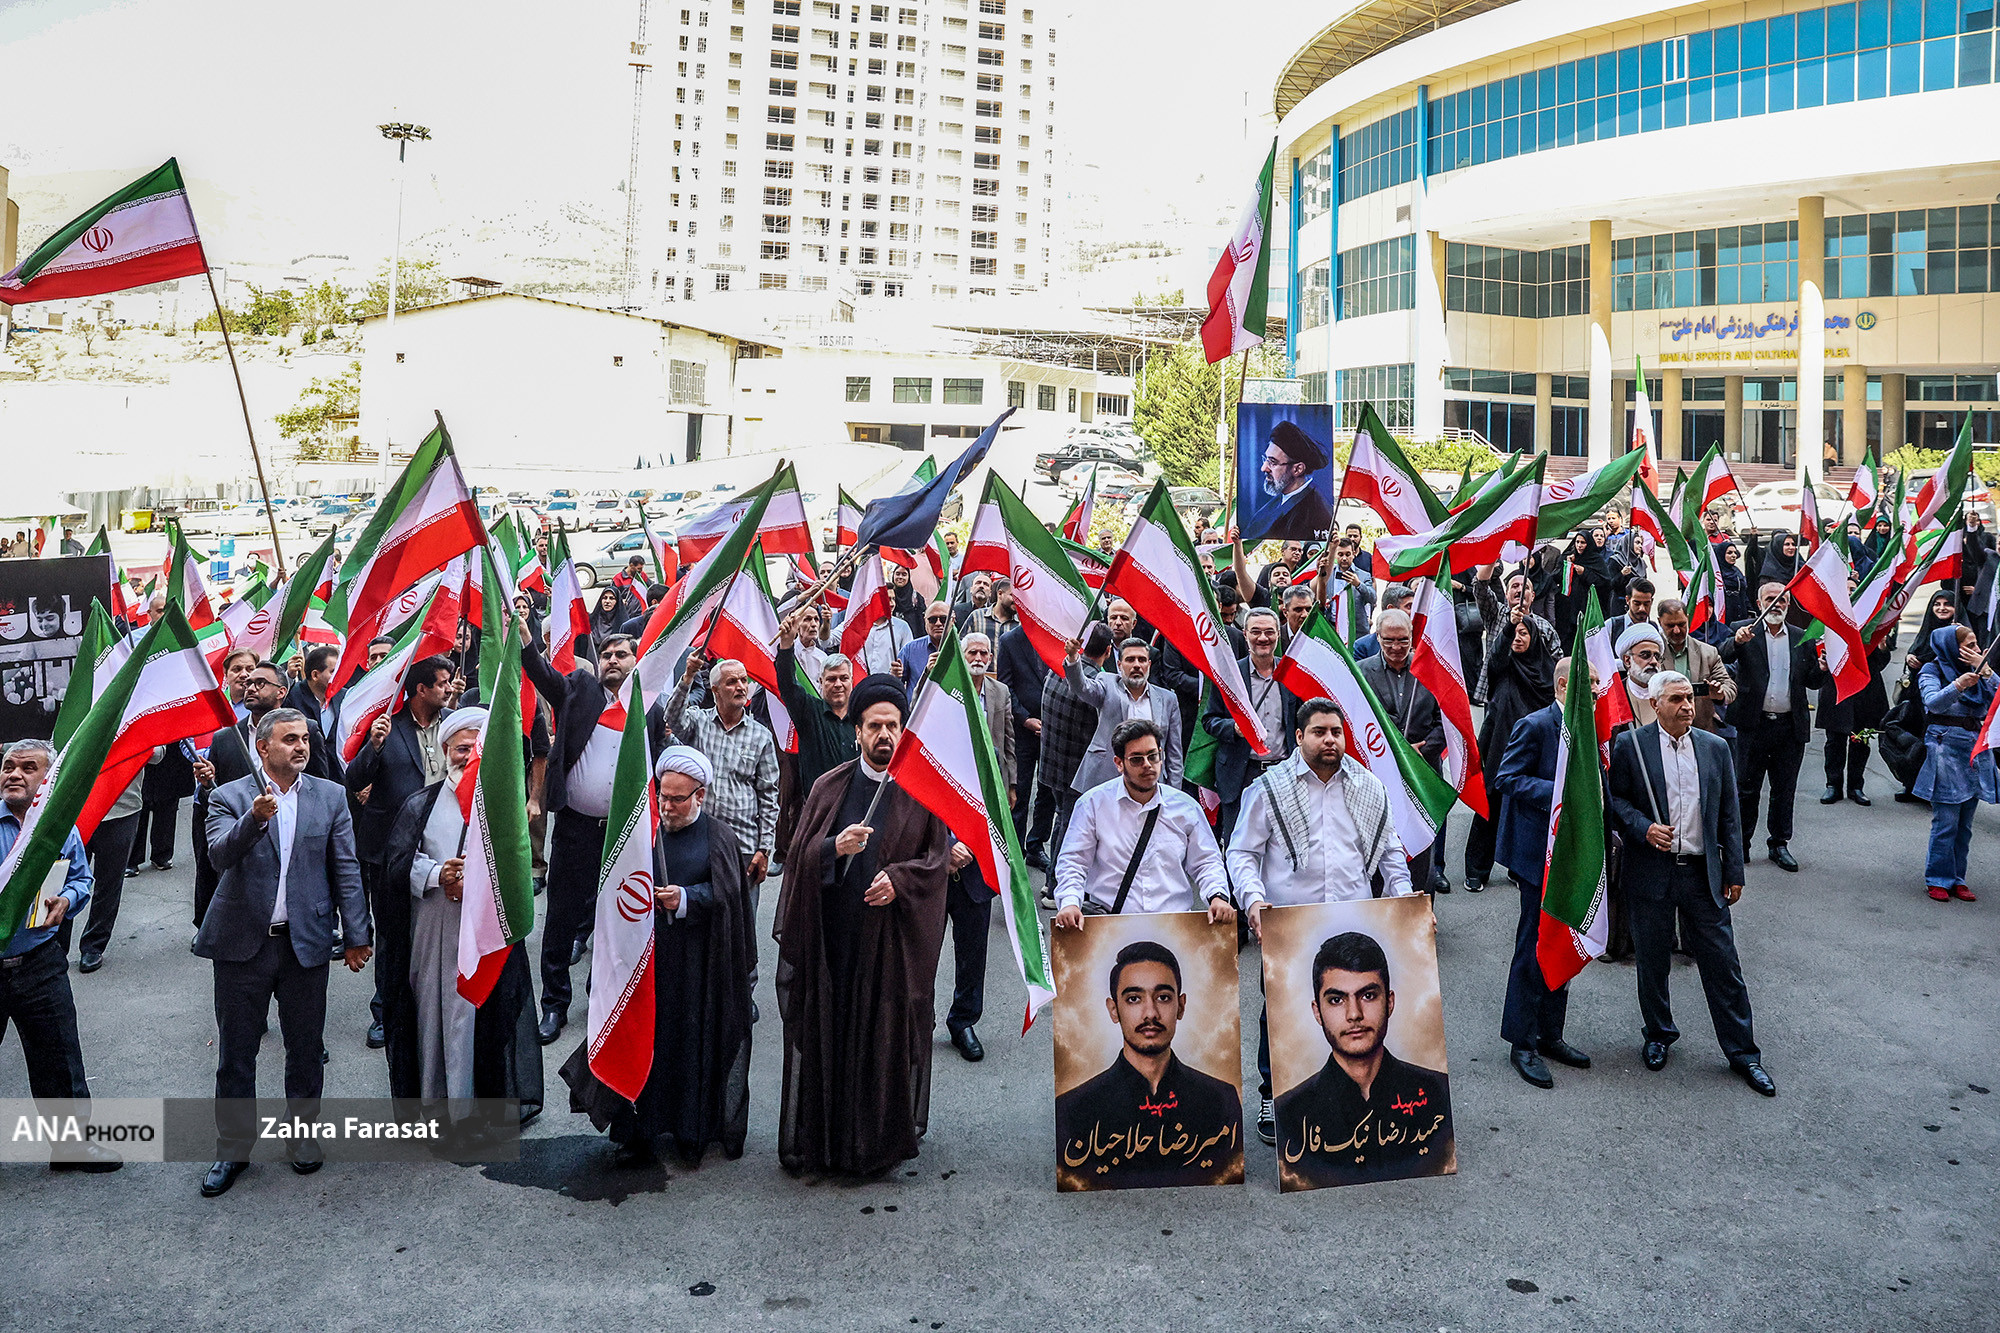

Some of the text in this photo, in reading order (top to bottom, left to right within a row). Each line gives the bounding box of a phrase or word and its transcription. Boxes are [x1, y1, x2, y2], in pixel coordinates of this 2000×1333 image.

[1672, 317, 1693, 342] علی
[1694, 315, 1716, 341] امام
[1716, 315, 1754, 340] ورزشی
[1695, 350, 1732, 362] SPORTS
[1734, 350, 1753, 361] AND
[1824, 347, 1850, 359] PLEX
[1138, 1090, 1179, 1118] شهید
[1390, 1088, 1429, 1116] شهید
[1064, 1119, 1154, 1174] حلاجیان
[1285, 1115, 1321, 1164] فال
[1323, 1109, 1374, 1164] نیک
